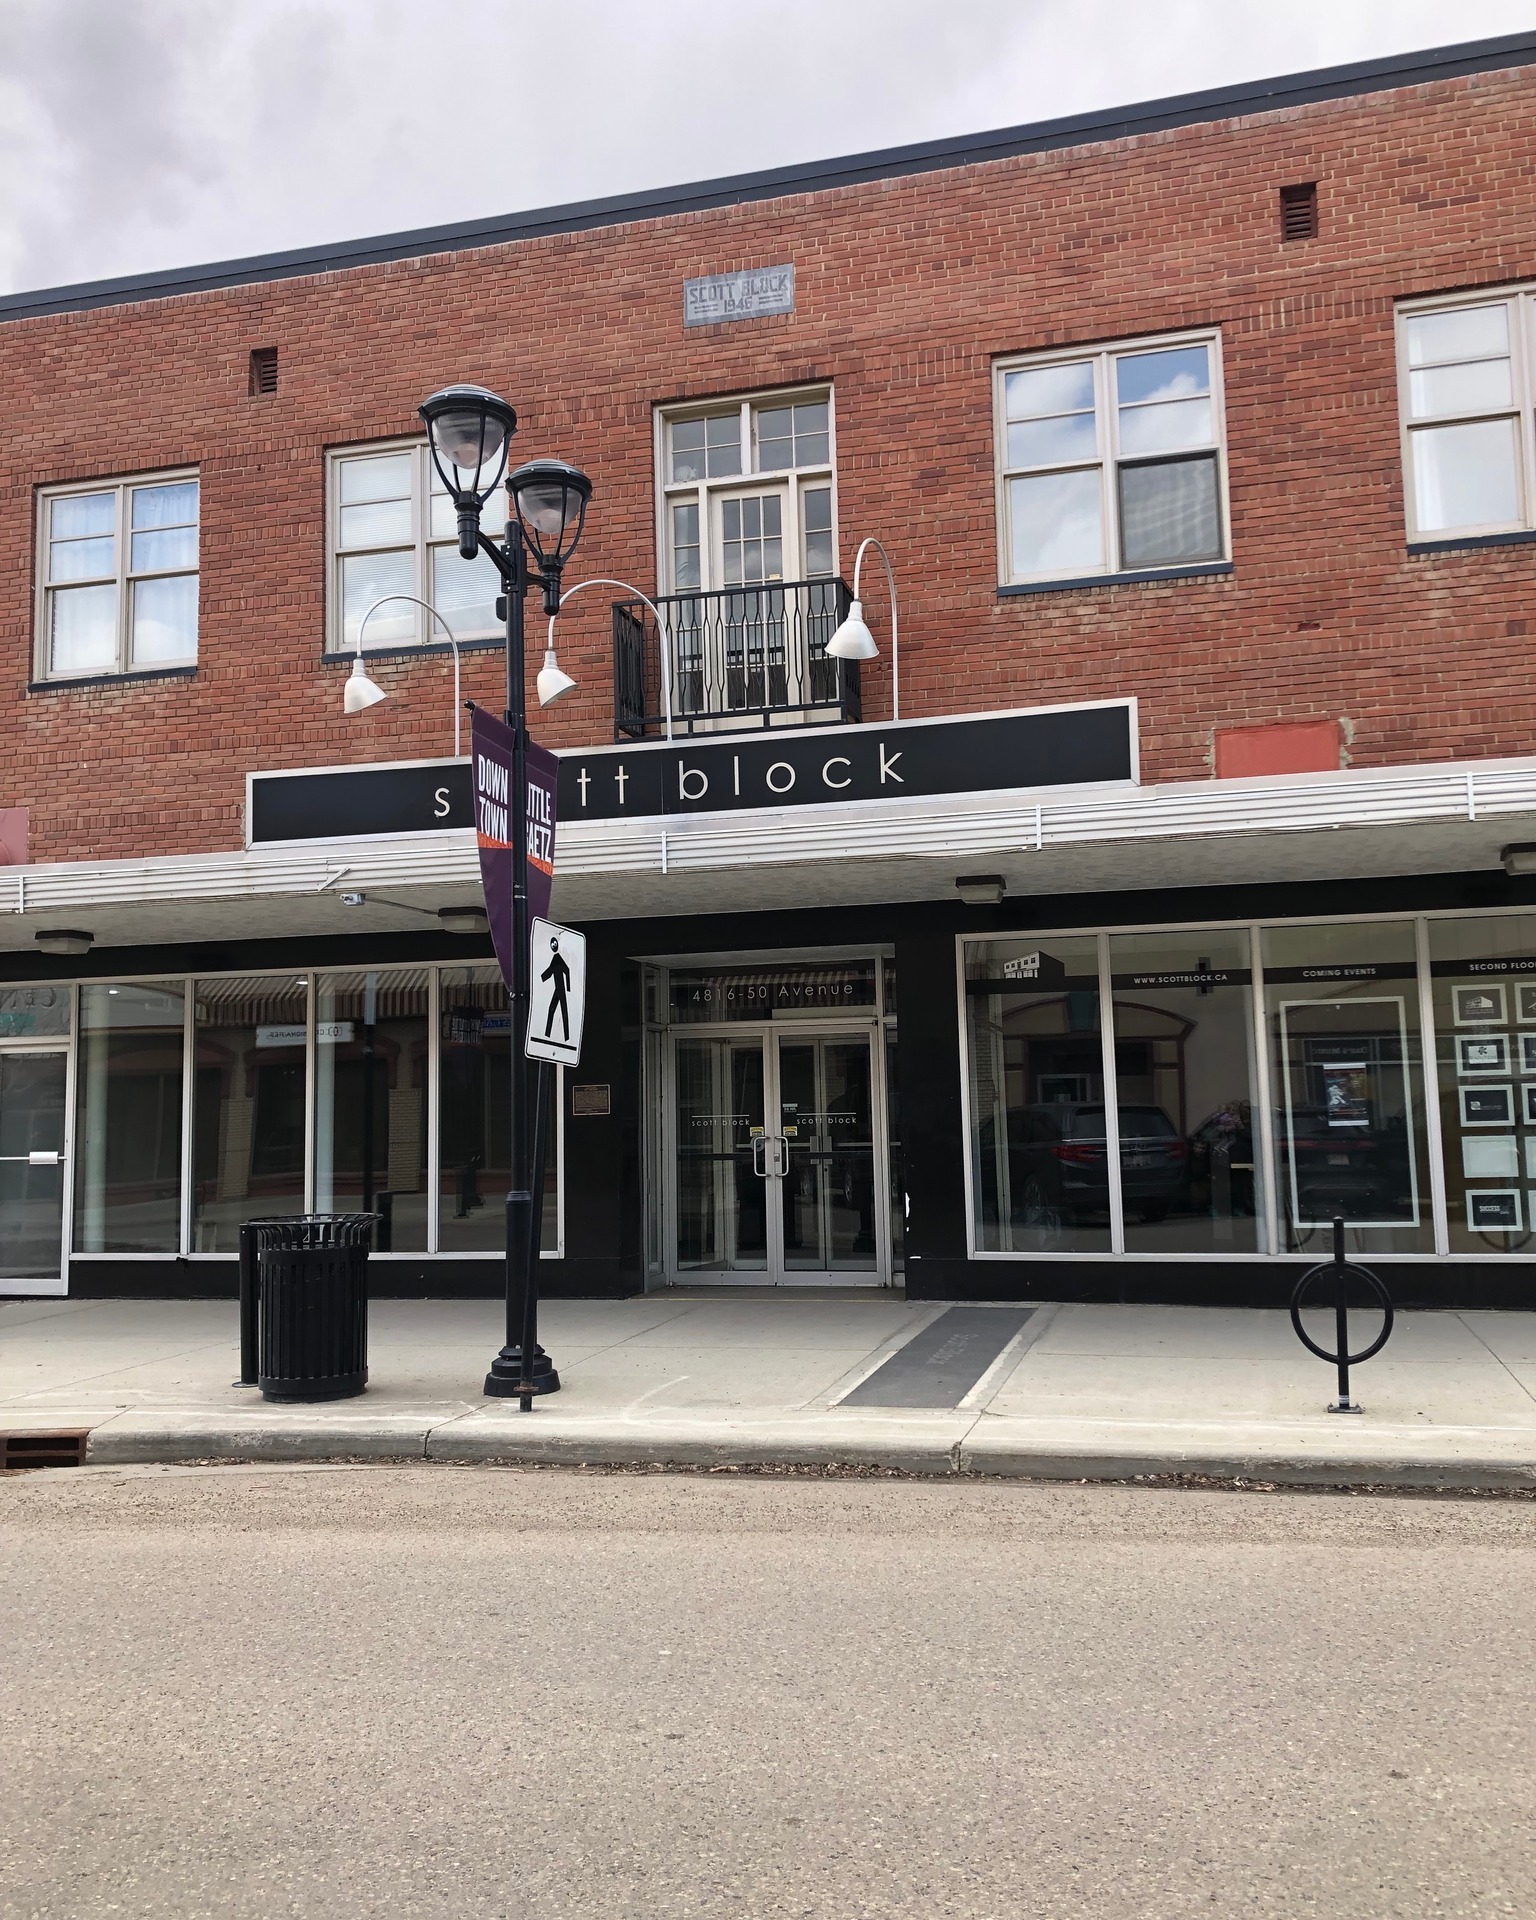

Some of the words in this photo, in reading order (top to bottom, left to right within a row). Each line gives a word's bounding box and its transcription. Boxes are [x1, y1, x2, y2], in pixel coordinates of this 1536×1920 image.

[690, 282, 735, 304] SCOTT
[741, 274, 788, 297] BLOCK
[724, 296, 752, 313] 1946
[434, 765, 629, 818] stt
[679, 743, 904, 800] block
[478, 754, 508, 805] DOWN
[479, 796, 508, 845] TOWN
[1303, 969, 1341, 977] COMING
[1469, 963, 1507, 971] SECOND
[1133, 974, 1228, 984] WWW.SCOTTBLOCK.CA
[692, 986, 767, 1001] 4816-50
[778, 984, 853, 998] Avenue
[691, 1119, 717, 1127] scott
[722, 1118, 750, 1126] block
[828, 1116, 857, 1124] block
